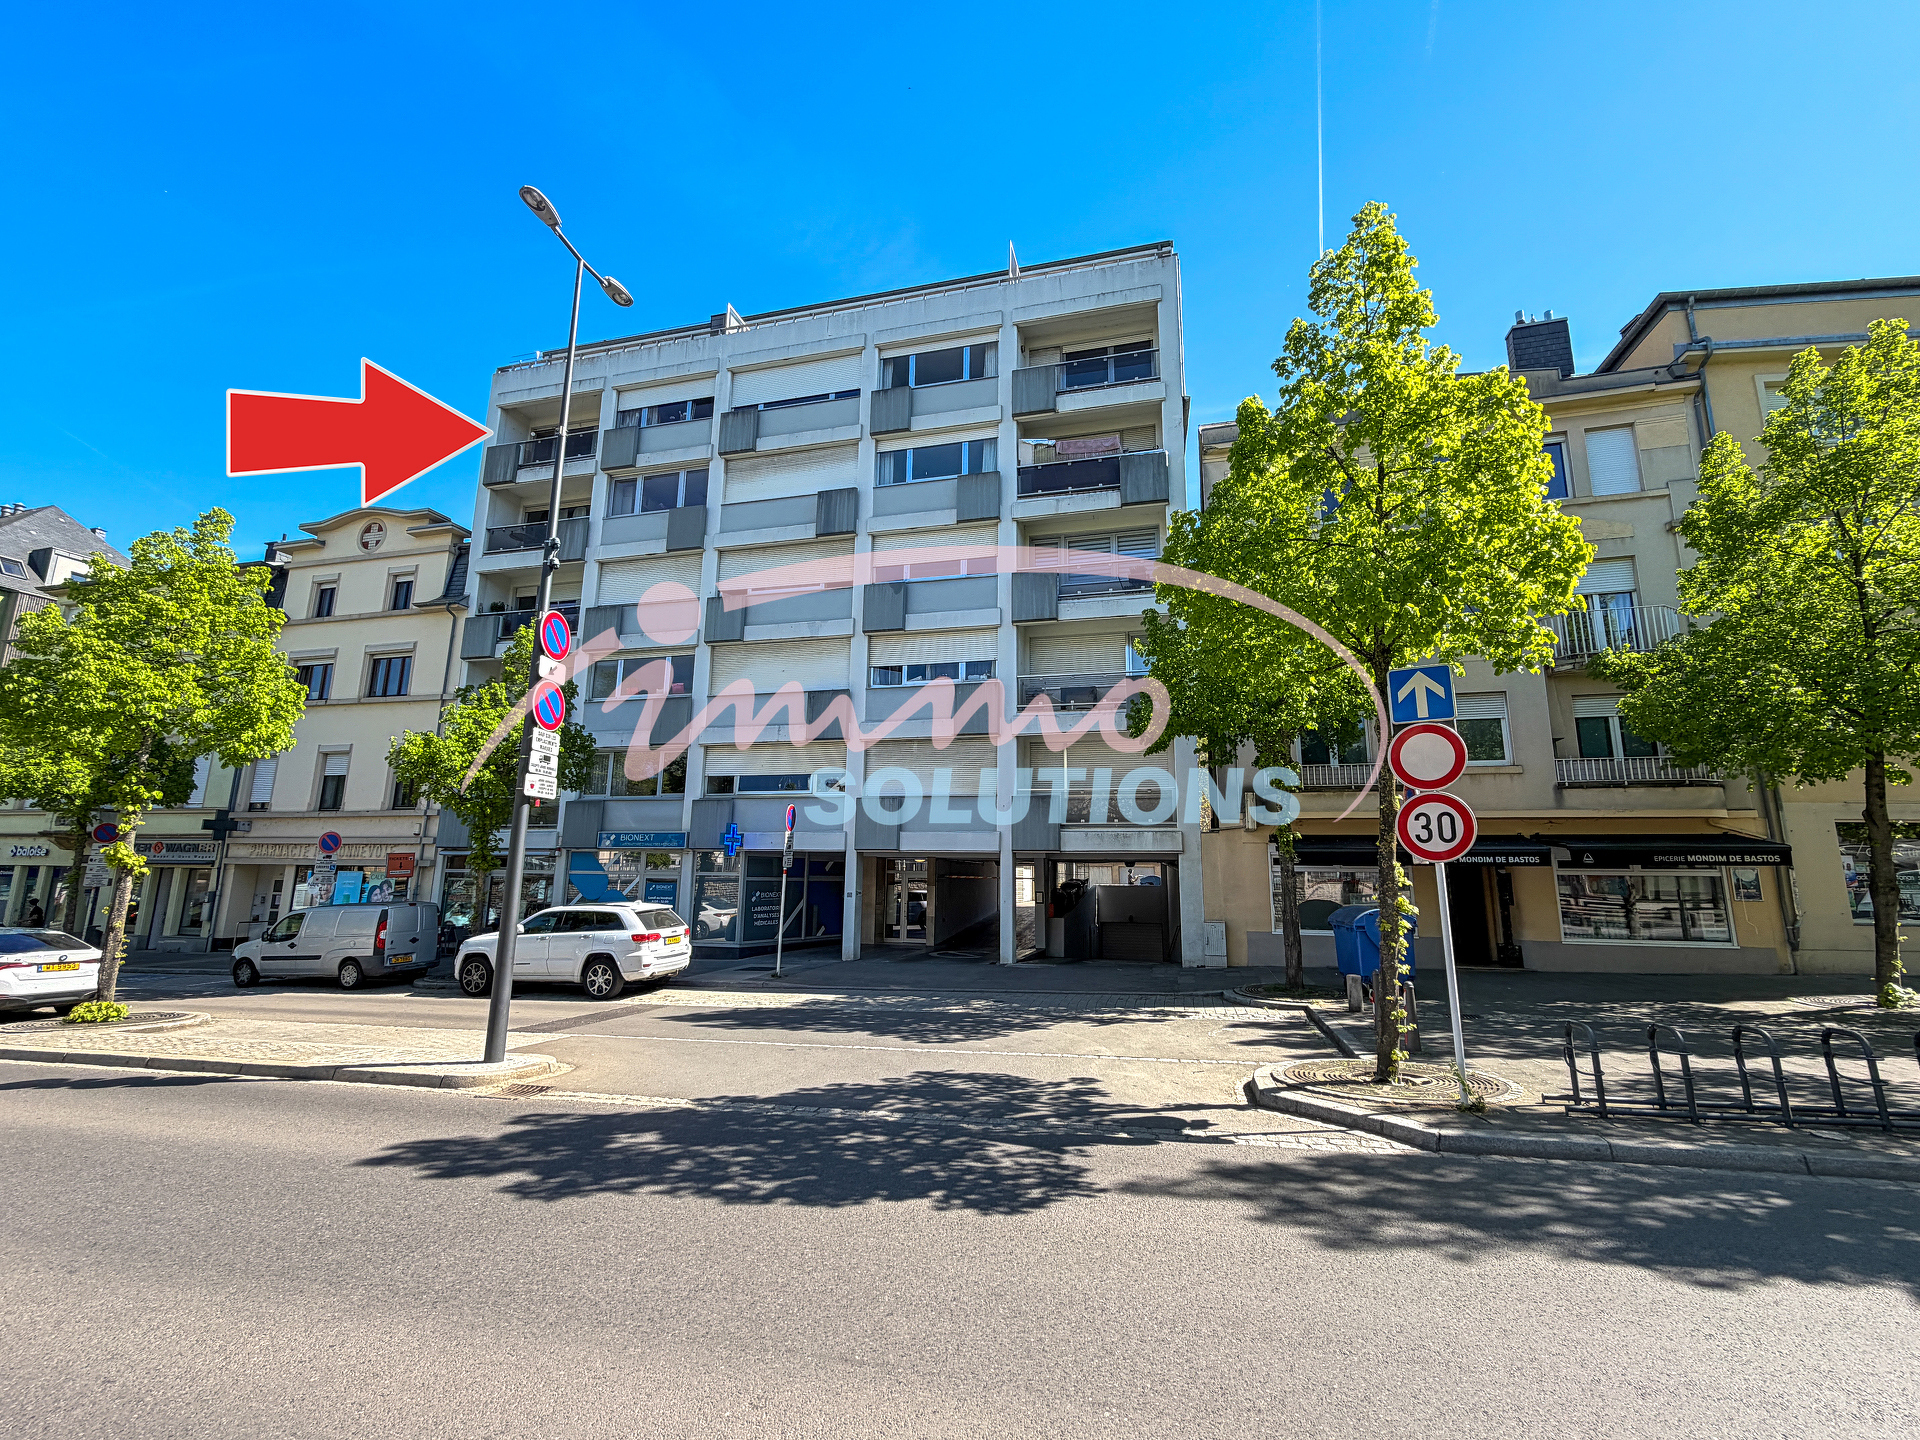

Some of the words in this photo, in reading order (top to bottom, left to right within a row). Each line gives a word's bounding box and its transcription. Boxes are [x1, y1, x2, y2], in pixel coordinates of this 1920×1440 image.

[1413, 811, 1457, 844] 30
[620, 833, 655, 842] BIONEXT
[16, 846, 47, 857] baloise
[165, 843, 216, 853] WAGNER
